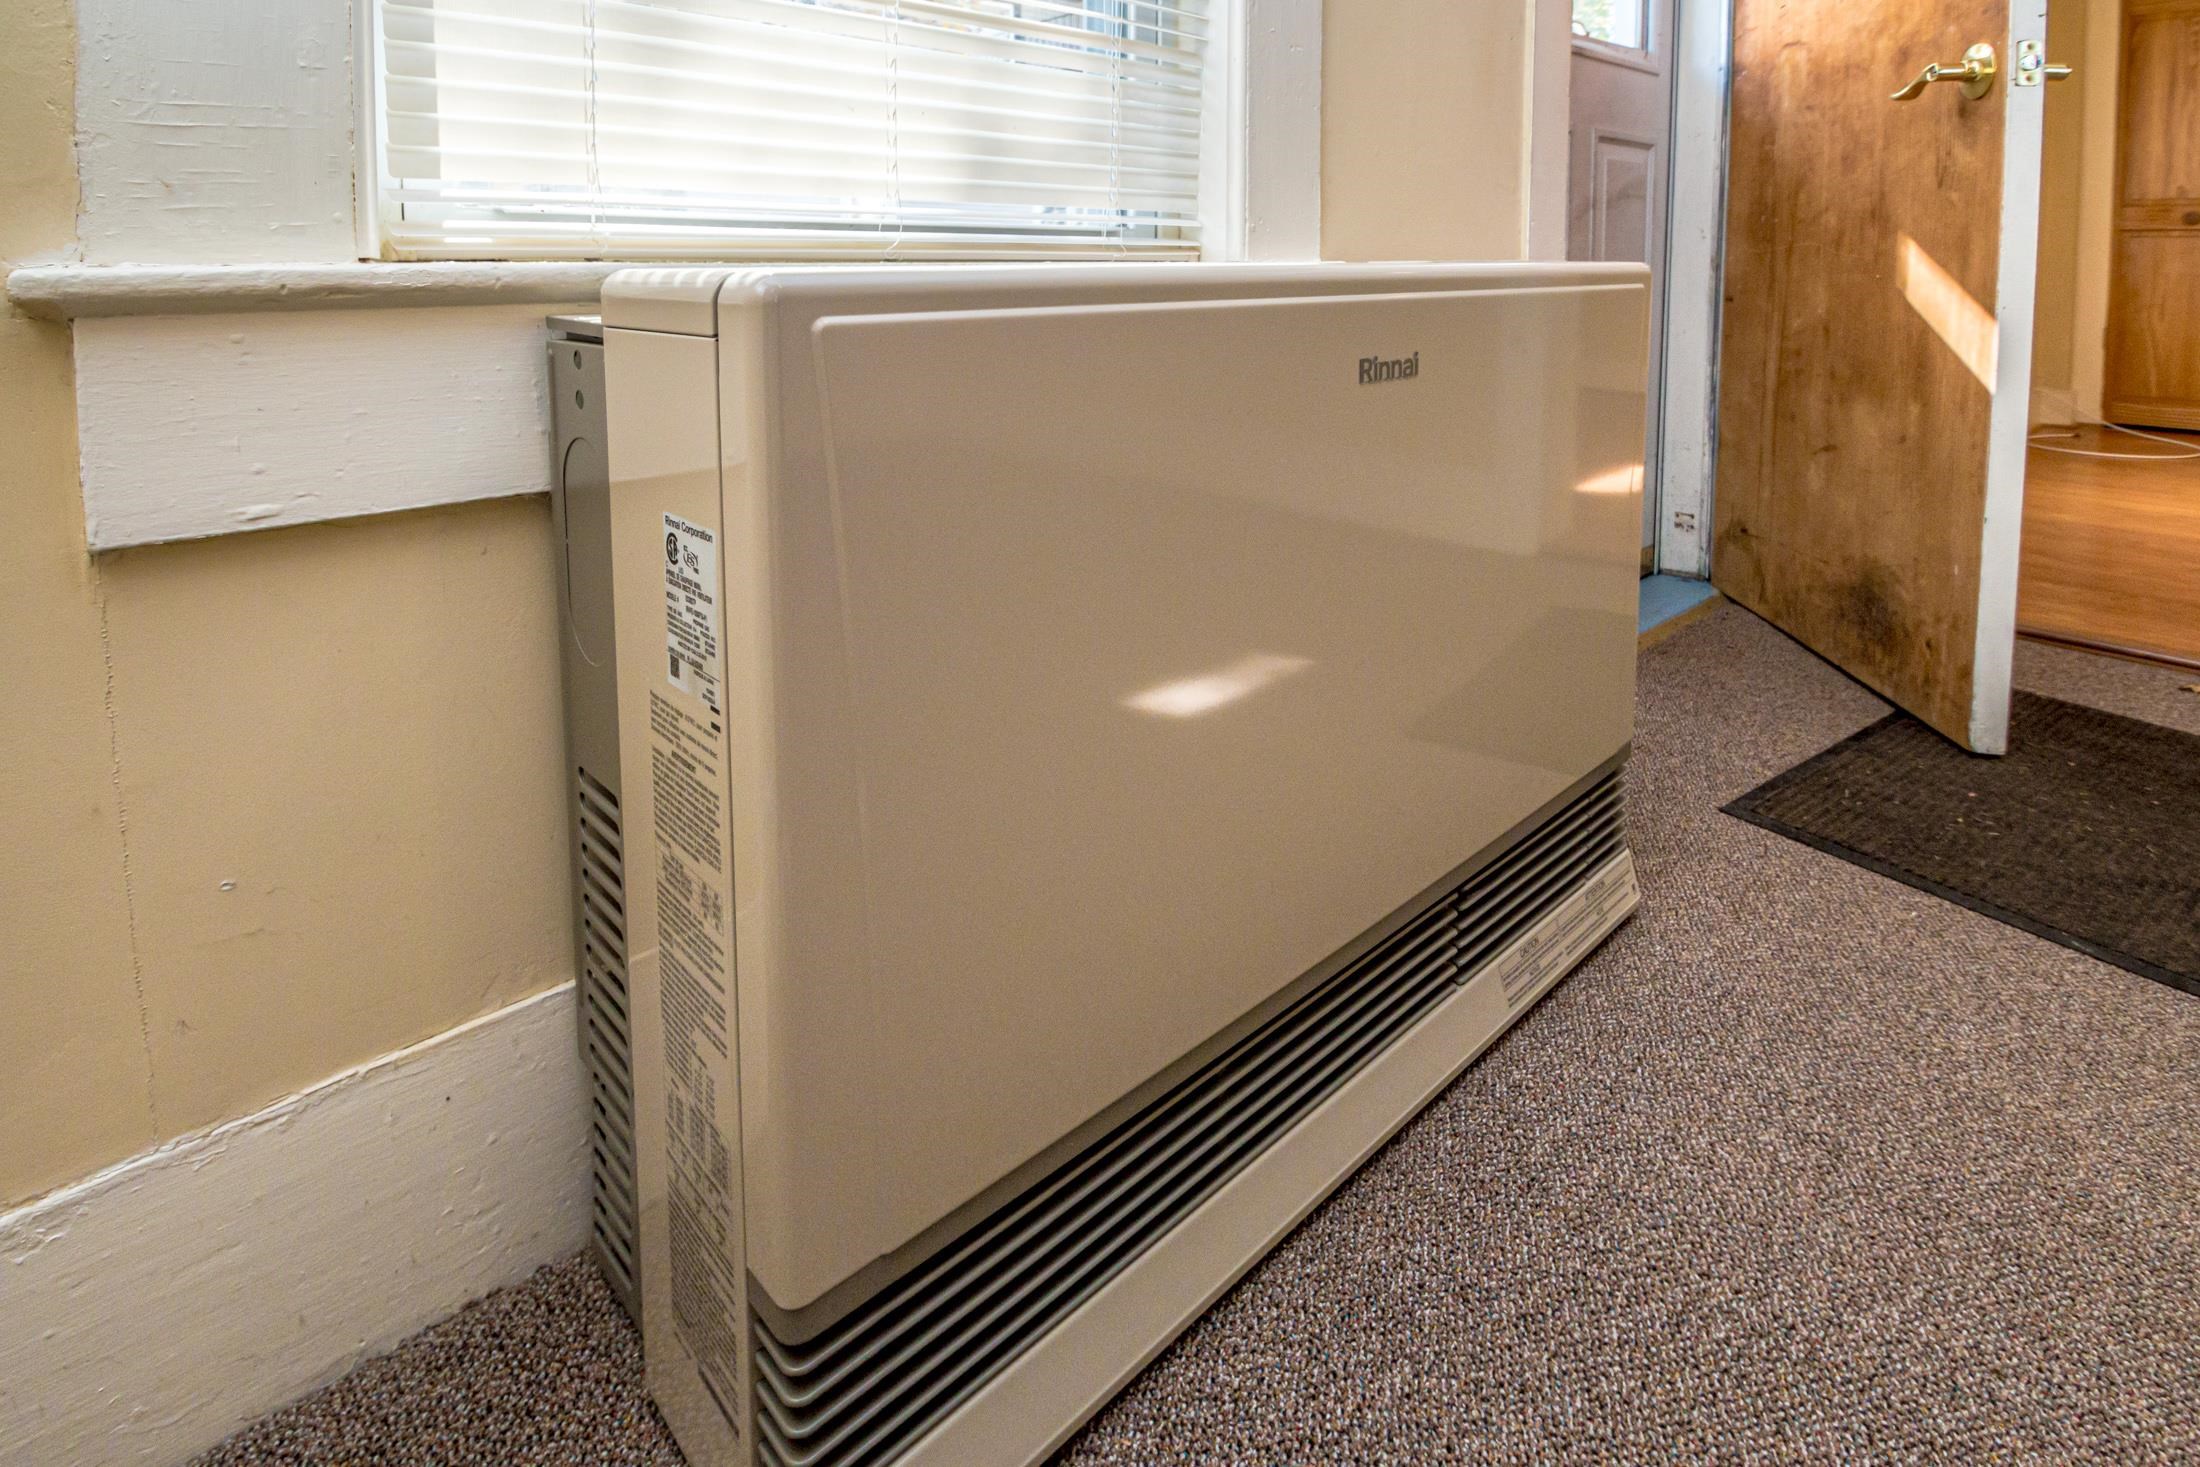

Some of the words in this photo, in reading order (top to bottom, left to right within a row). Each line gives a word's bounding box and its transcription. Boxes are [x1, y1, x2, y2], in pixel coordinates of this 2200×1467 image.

[1359, 351, 1419, 384] Rinnai
[665, 515, 680, 529] Rinnai
[681, 521, 713, 543] Corporation
